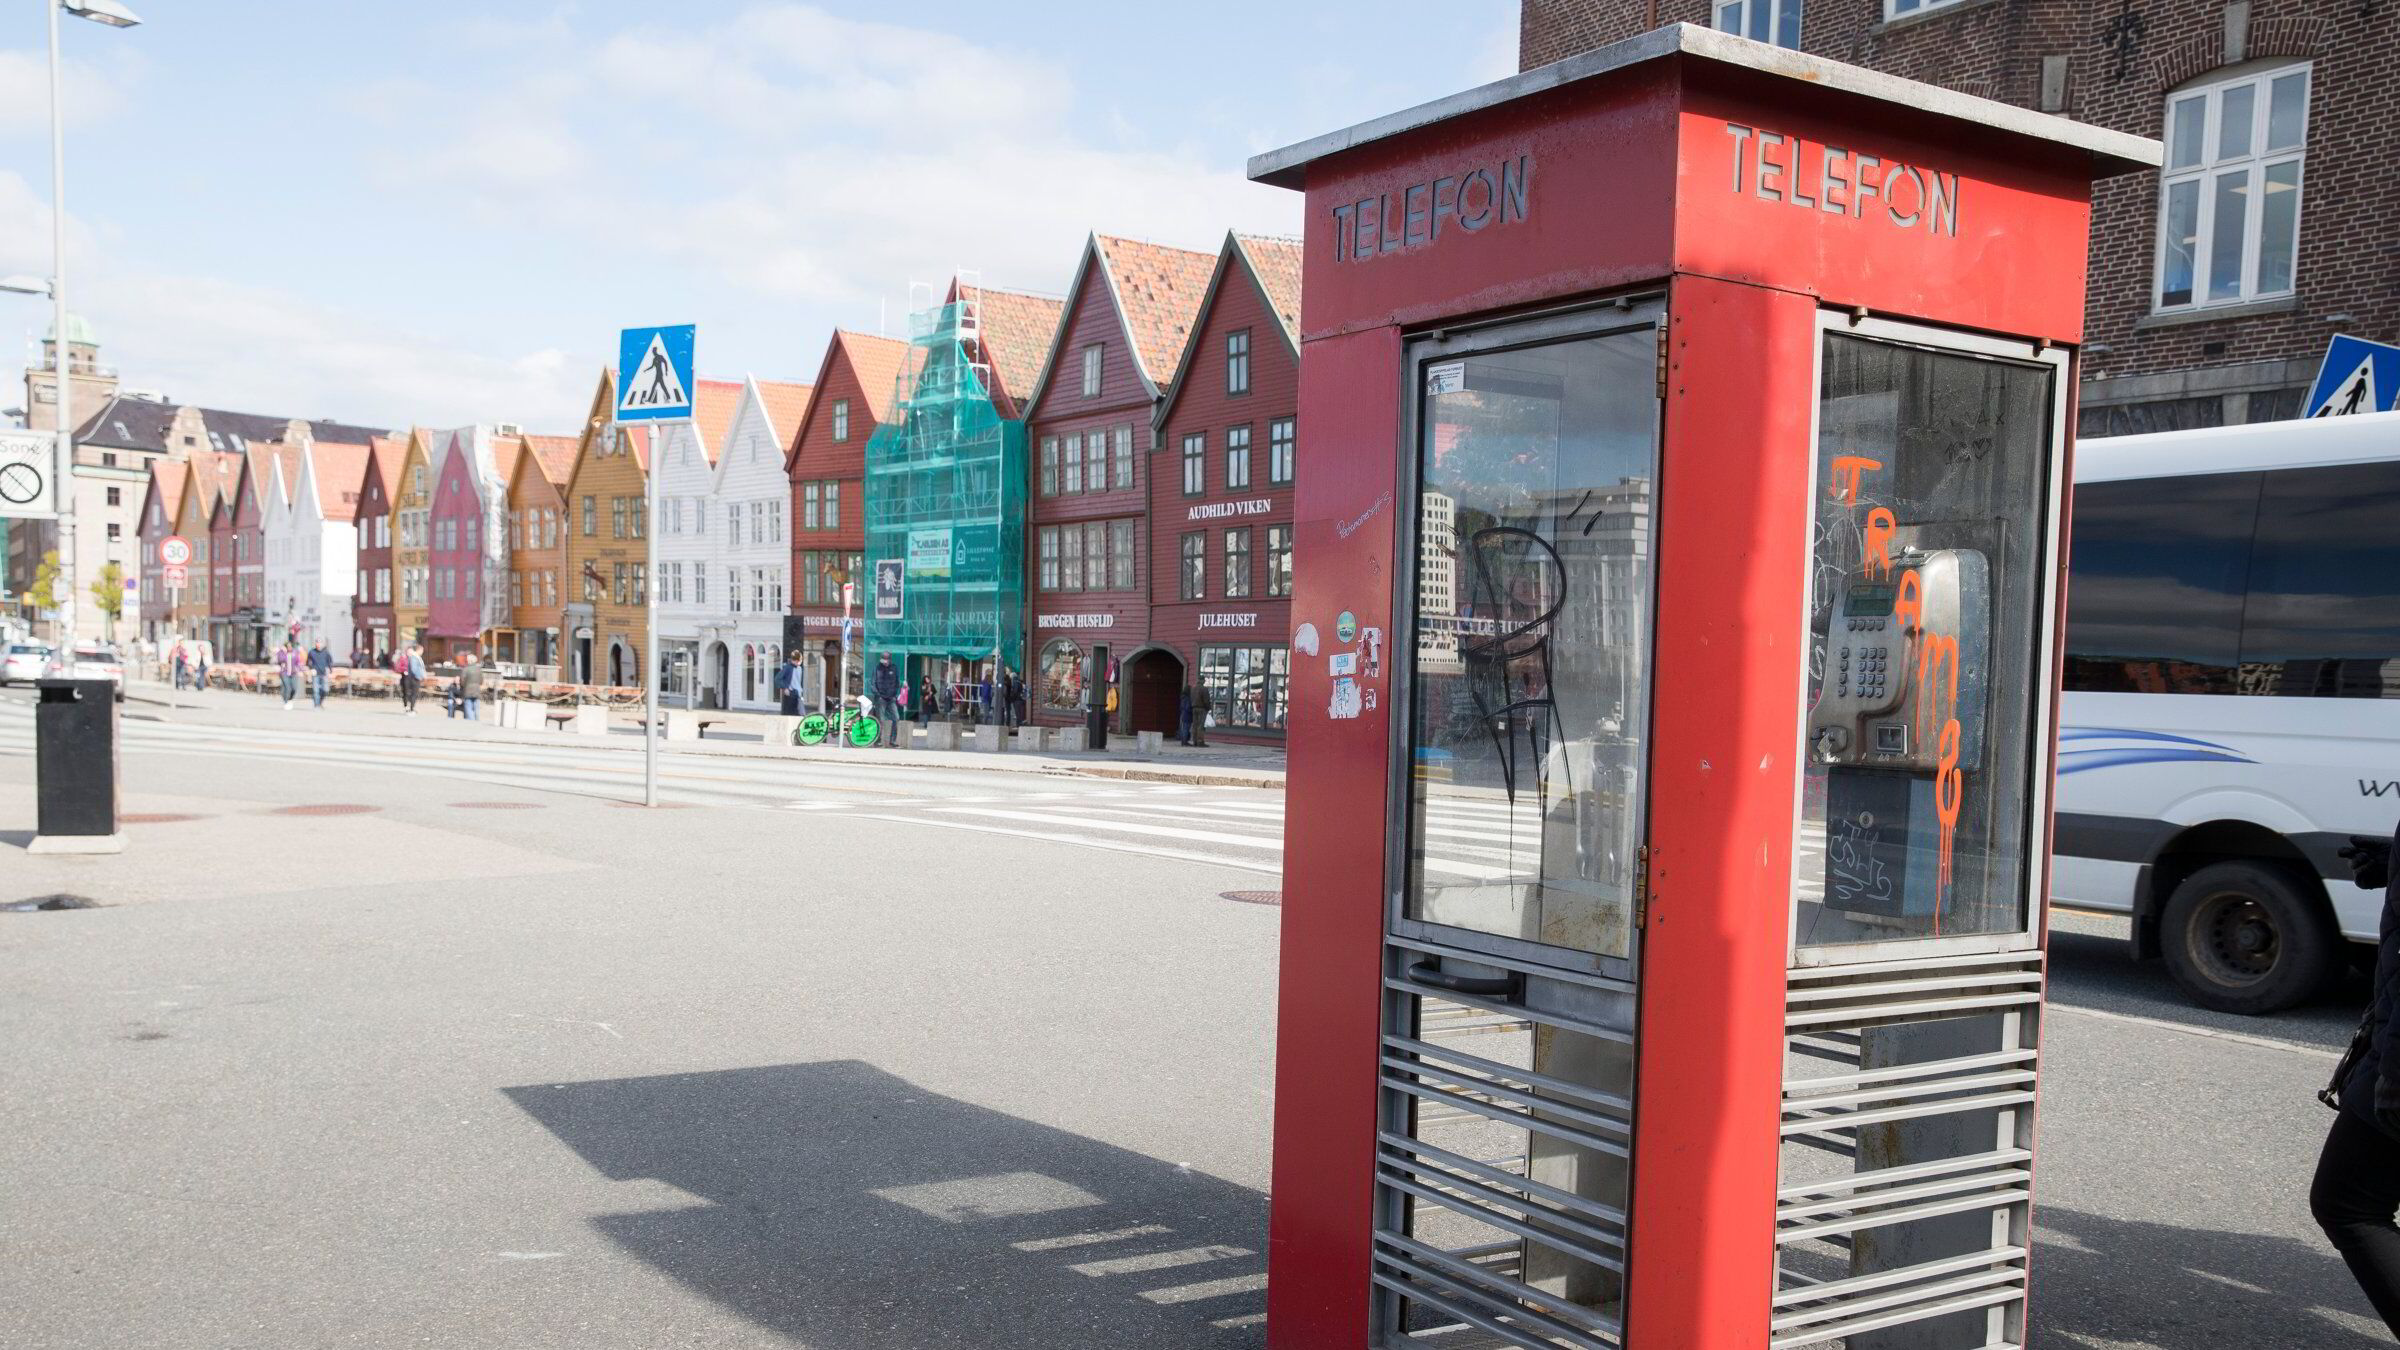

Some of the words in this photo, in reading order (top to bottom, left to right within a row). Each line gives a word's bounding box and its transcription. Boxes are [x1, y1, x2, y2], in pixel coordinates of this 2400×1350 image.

[1727, 122, 1959, 237] TELEFON
[1333, 156, 1528, 262] TELEFON
[1188, 503, 1234, 520] AUDHILD
[1236, 499, 1271, 515] VIKEN
[167, 545, 185, 559] 30
[951, 611, 1005, 625] SKURTVET
[1038, 614, 1075, 628] BRYGGEN
[1077, 614, 1113, 628] HUSFLID
[1198, 613, 1257, 630] JULEHUSET
[2358, 779, 2400, 798] w
